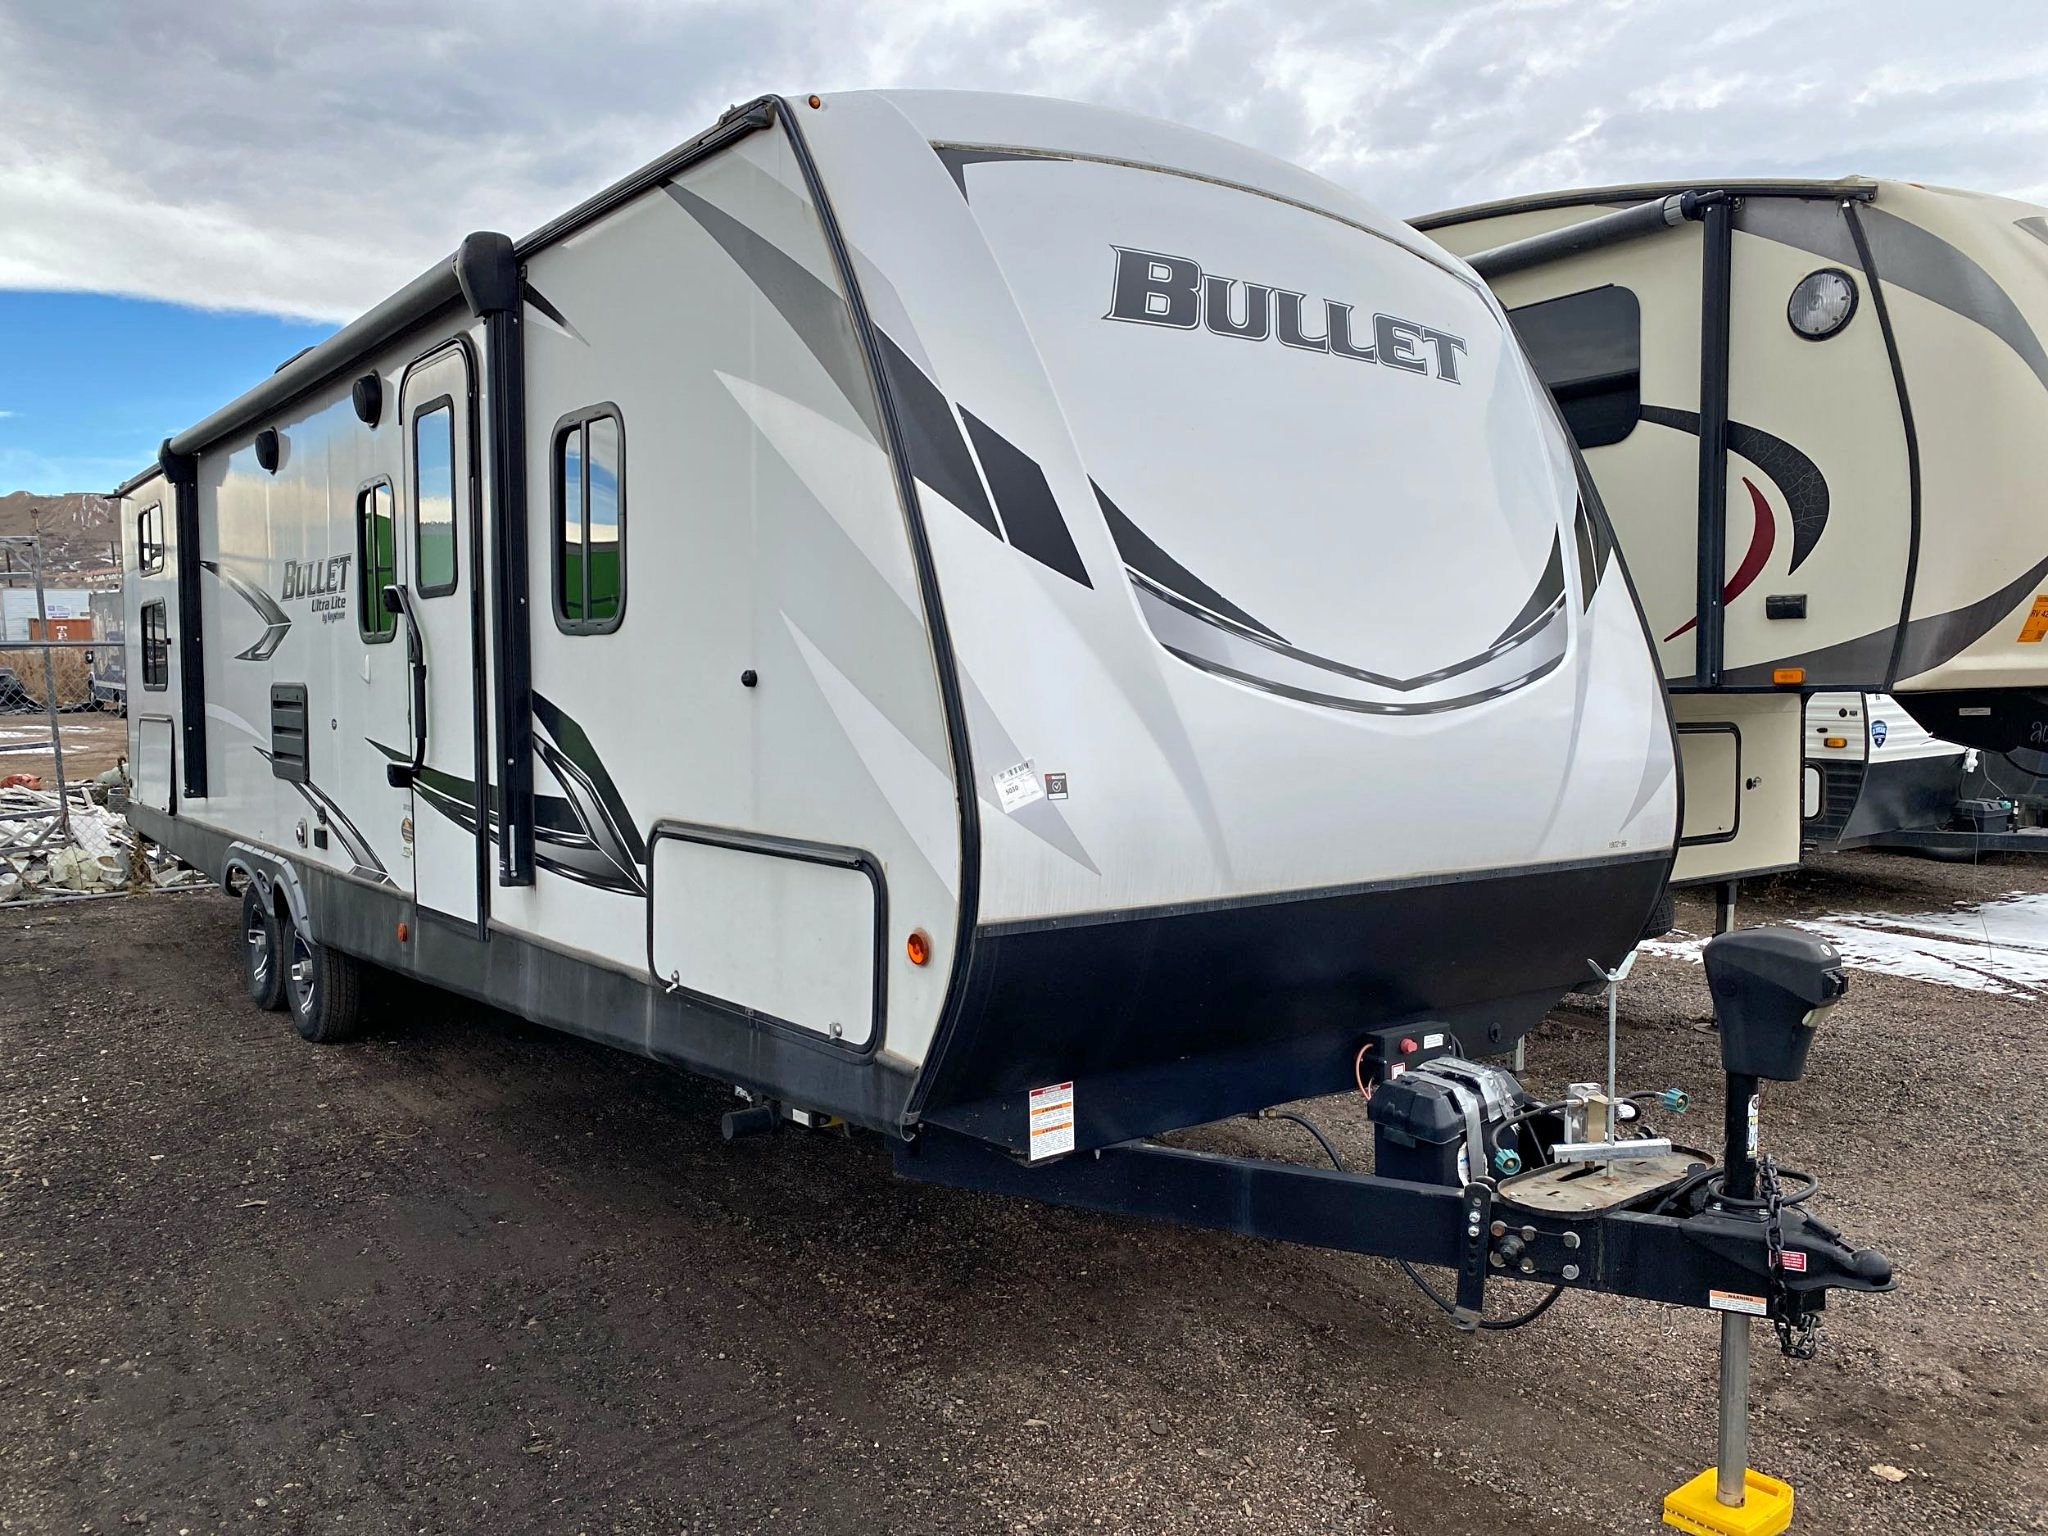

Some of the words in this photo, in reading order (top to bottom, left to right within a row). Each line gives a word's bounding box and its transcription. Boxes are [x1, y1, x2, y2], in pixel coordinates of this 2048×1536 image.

[1101, 244, 1468, 385] BULLET
[280, 553, 352, 603] BULLET
[312, 599, 330, 613] Ultra
[331, 596, 346, 610] Lite
[1727, 1294, 1754, 1302] WARNING
